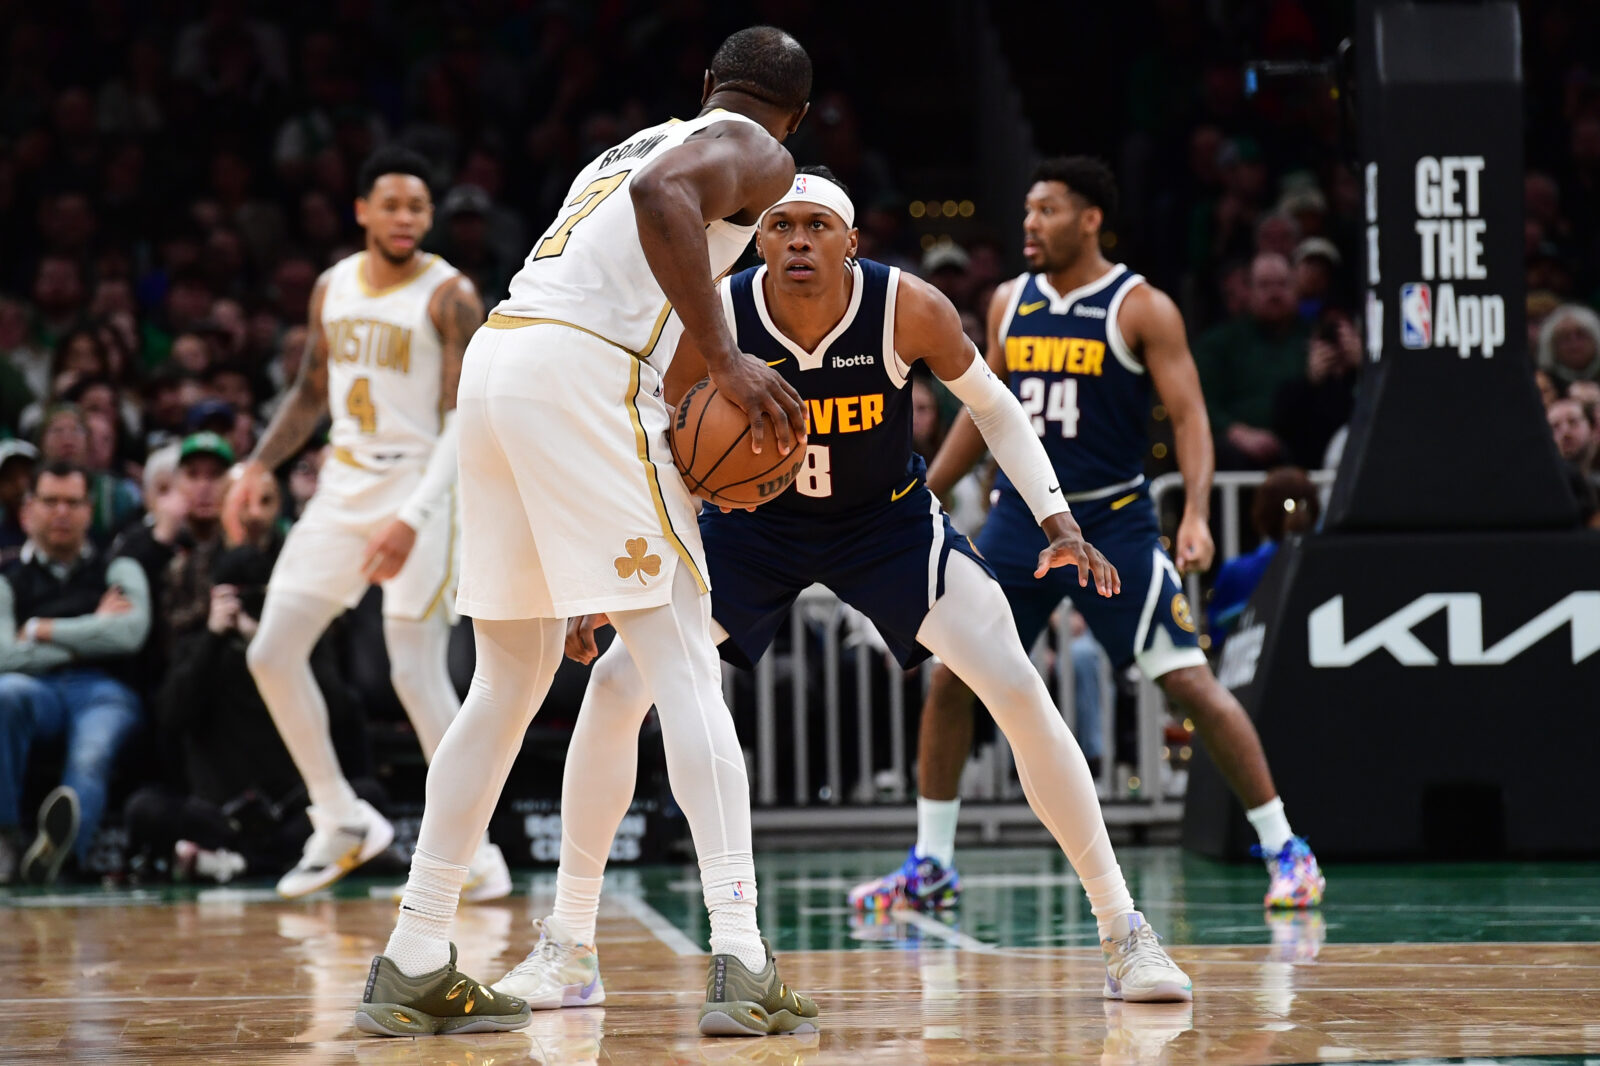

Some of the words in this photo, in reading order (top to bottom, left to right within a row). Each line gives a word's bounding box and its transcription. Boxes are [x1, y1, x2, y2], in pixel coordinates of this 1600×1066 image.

[532, 169, 632, 262] 7
[1415, 156, 1485, 217] GET
[1415, 219, 1487, 280] THE
[1434, 283, 1505, 358] App
[832, 354, 874, 369] ibotta
[1005, 336, 1106, 376] DENVER
[346, 377, 377, 434] 4
[803, 393, 884, 435] VER
[1020, 377, 1080, 438] 24
[796, 444, 832, 498] 8
